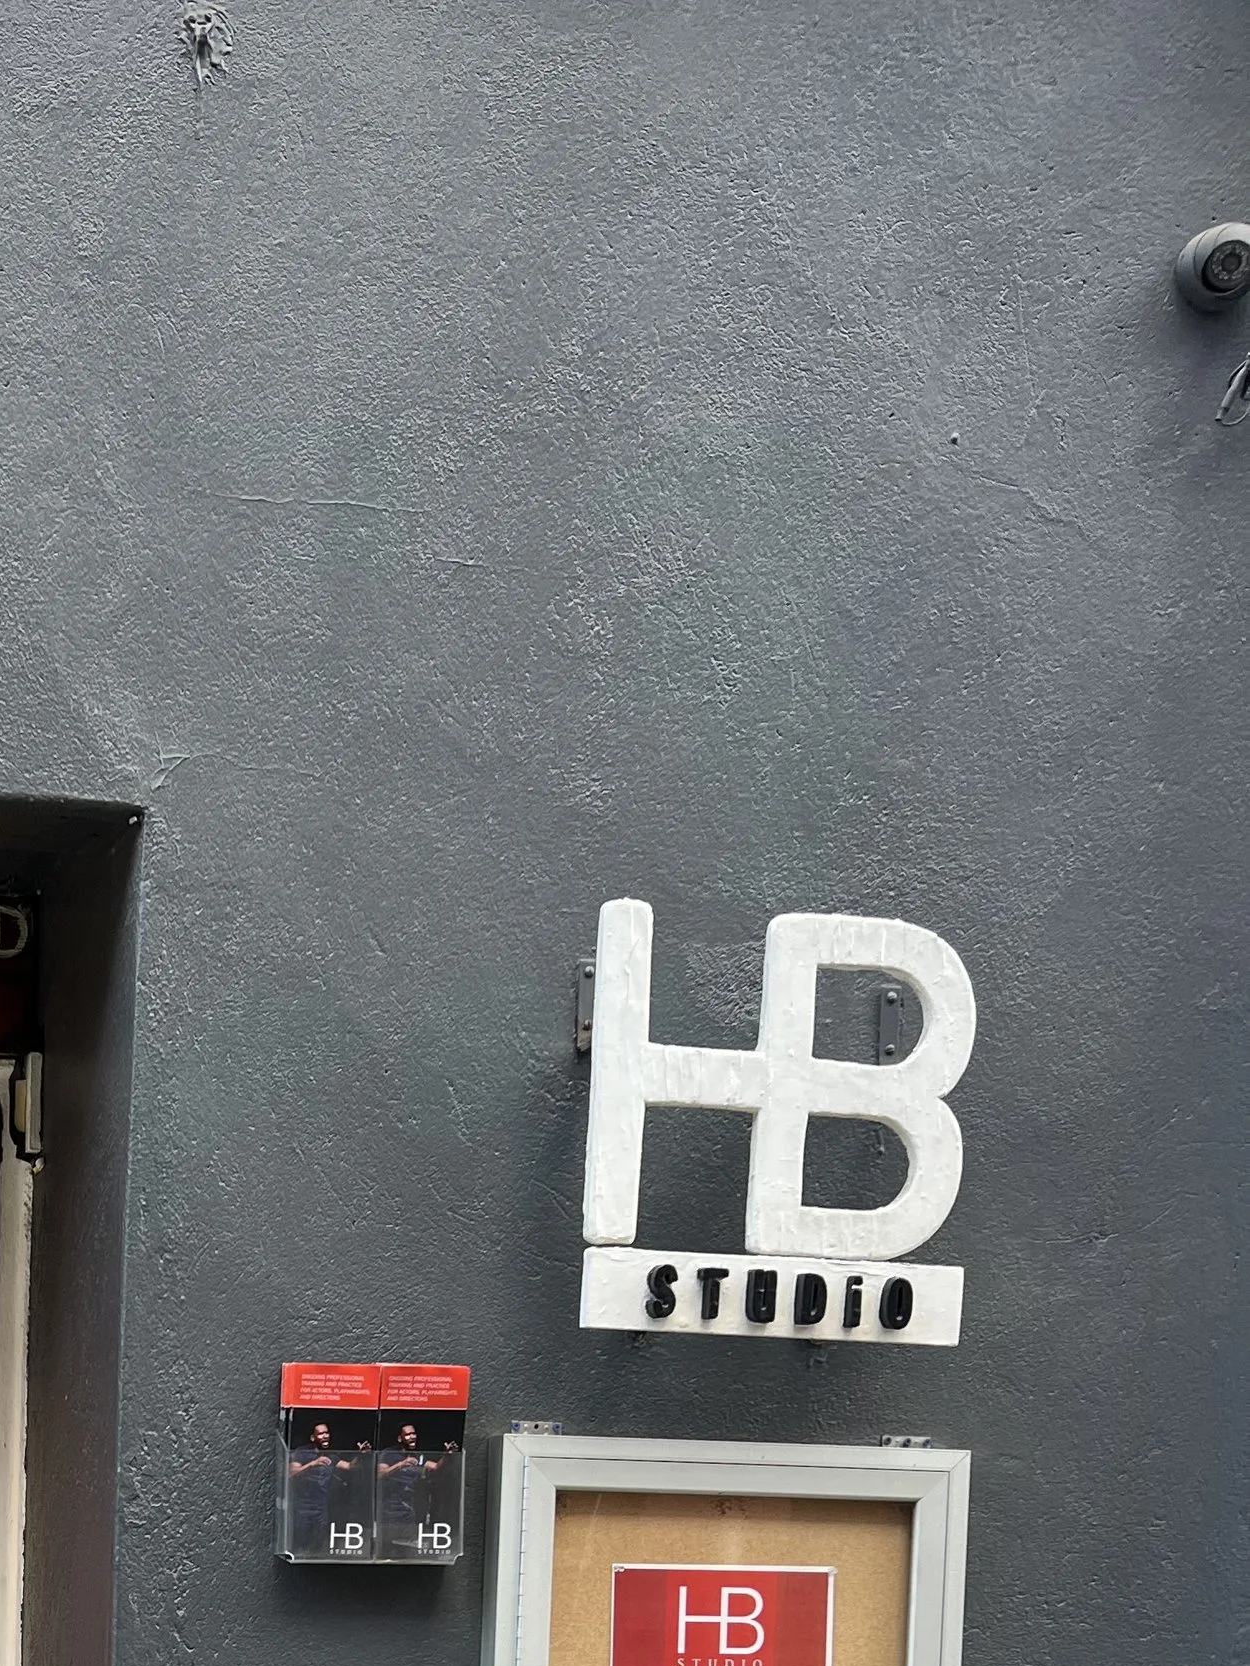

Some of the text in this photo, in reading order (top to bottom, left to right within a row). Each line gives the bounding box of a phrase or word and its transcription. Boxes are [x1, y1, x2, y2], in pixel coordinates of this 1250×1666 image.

[582, 897, 976, 1261] HB
[329, 1522, 364, 1549] HB
[417, 1522, 451, 1549] HB
[677, 1585, 765, 1655] HB
